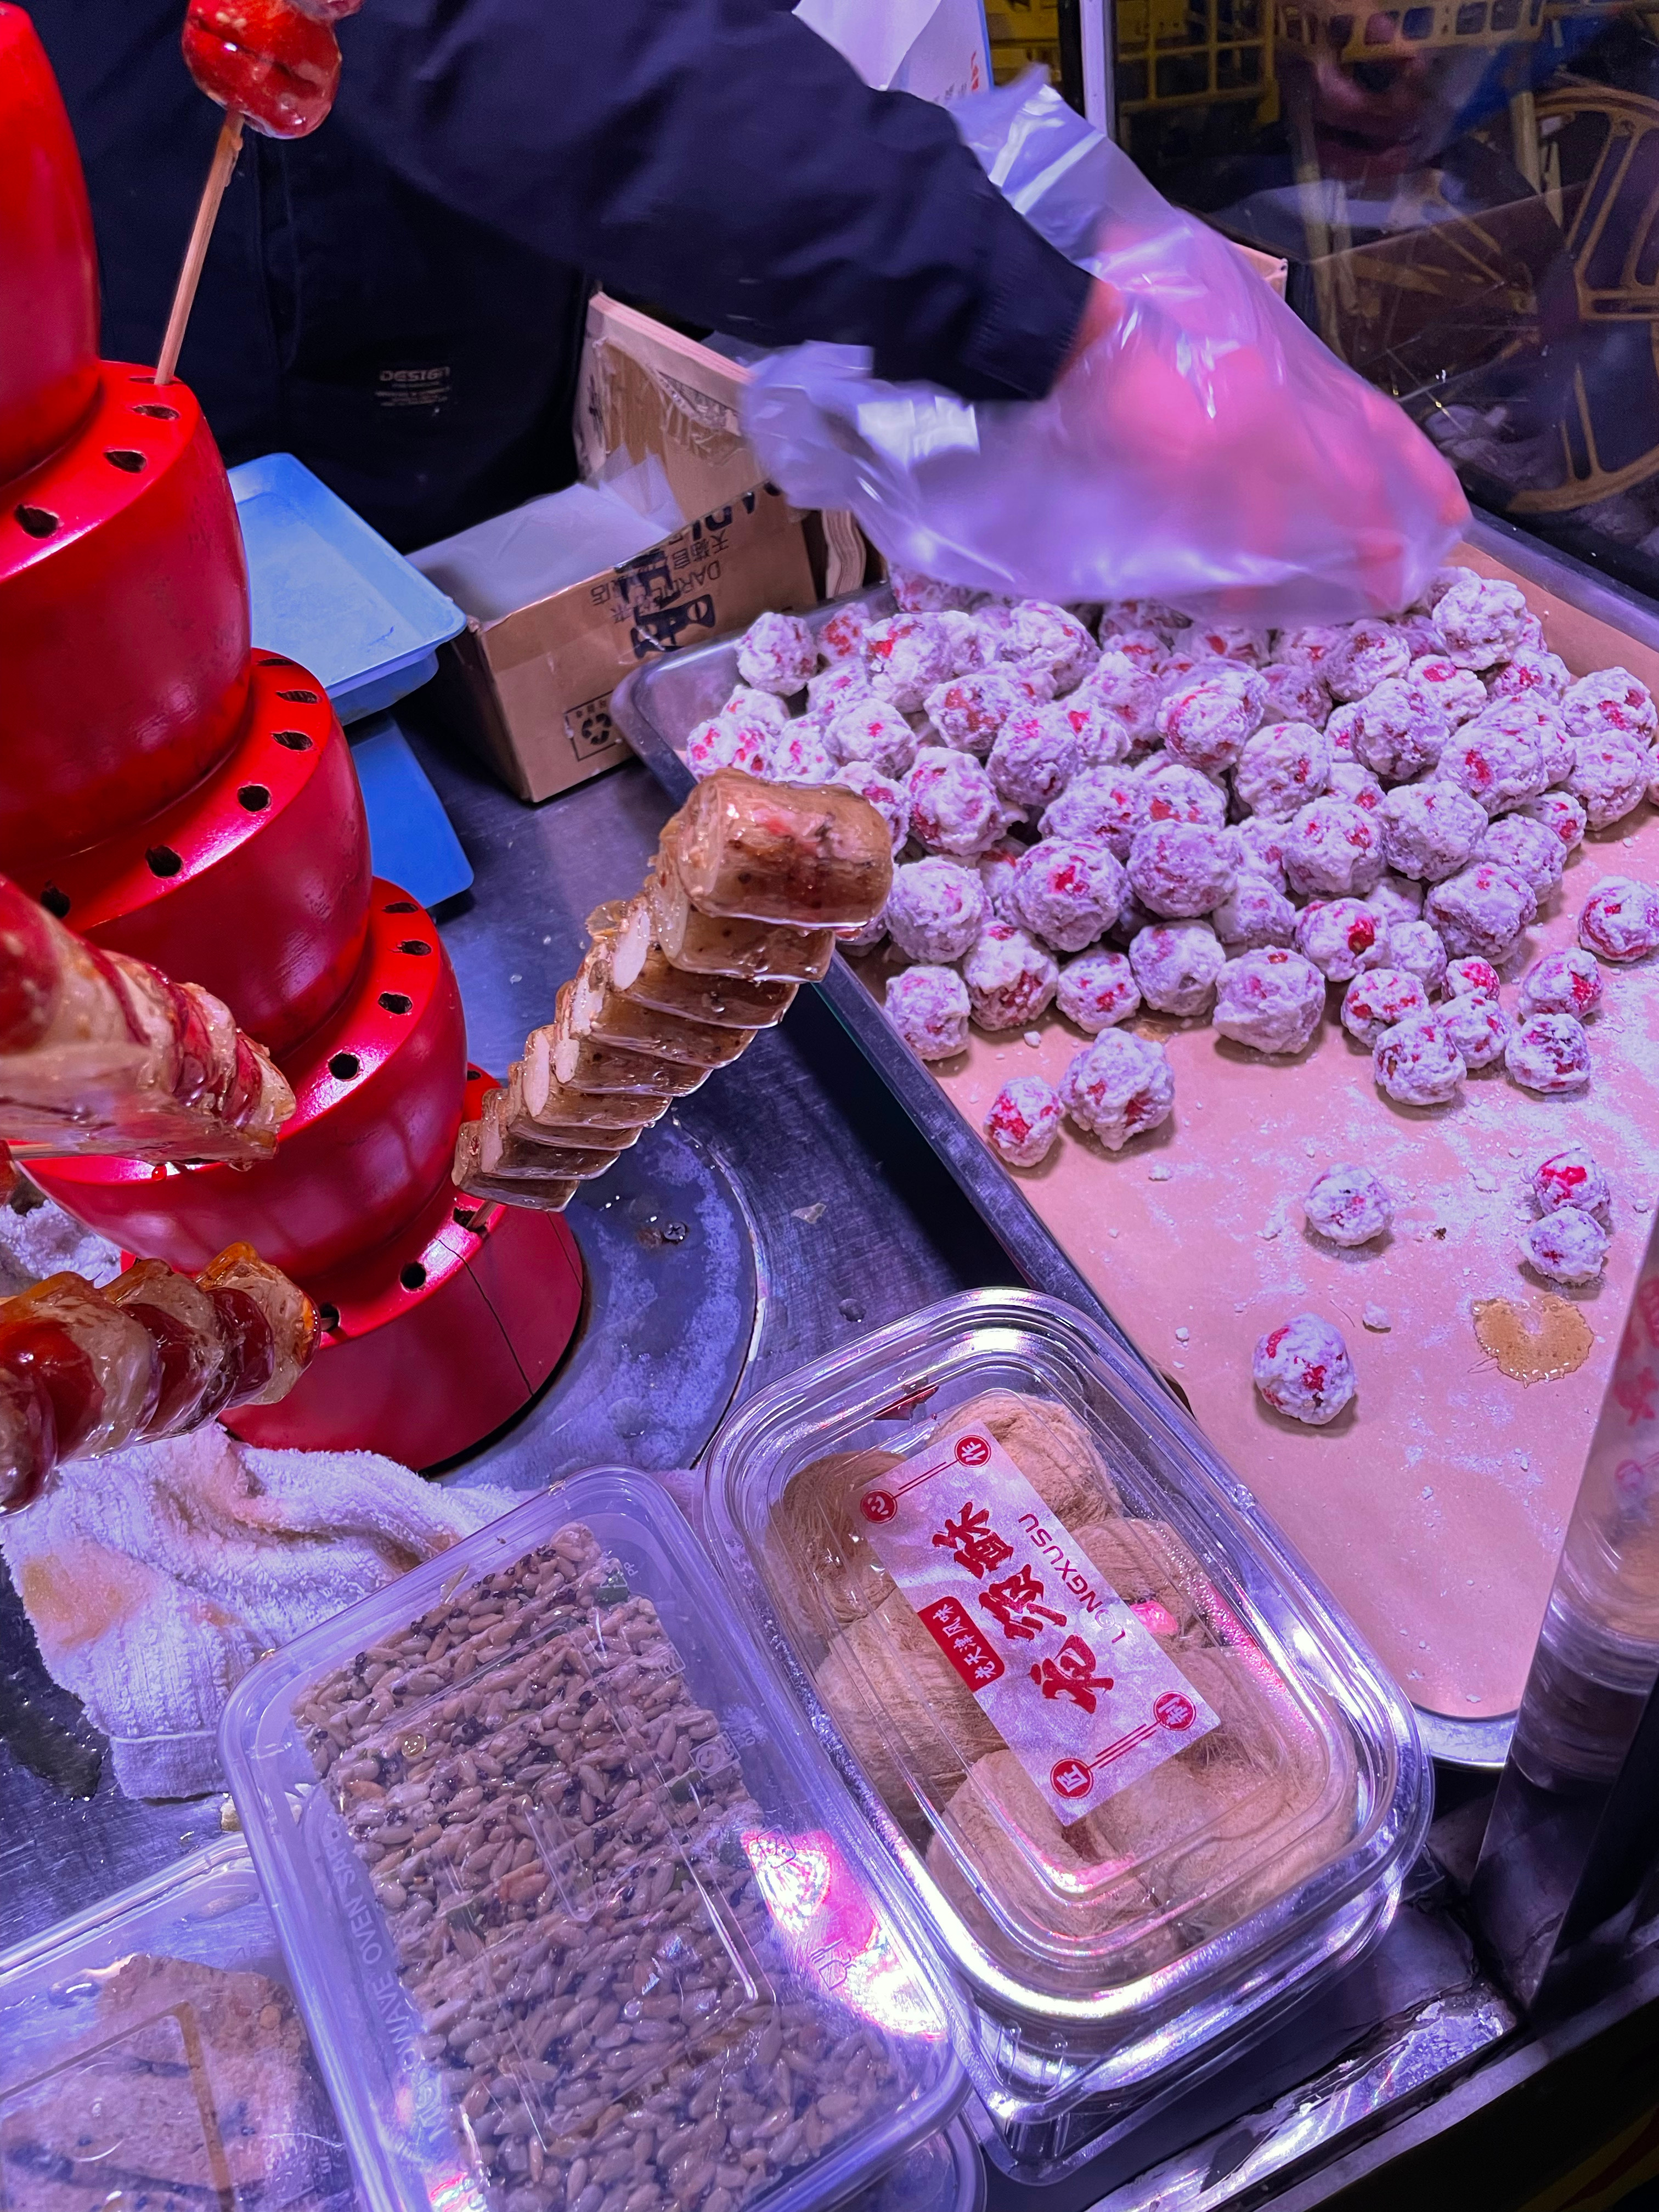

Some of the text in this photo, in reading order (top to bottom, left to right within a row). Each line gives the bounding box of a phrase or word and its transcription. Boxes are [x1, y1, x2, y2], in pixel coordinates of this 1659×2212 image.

[867, 1441, 986, 1515] 心 作
[623, 1561, 639, 1577] PP
[1018, 1513, 1126, 1644] LONGXUSU
[932, 1502, 1114, 1715] 龙须酥
[933, 1604, 997, 1680] 老天津风味
[1056, 1697, 1188, 1793] 匠 制
[345, 1894, 382, 1965] OVEN
